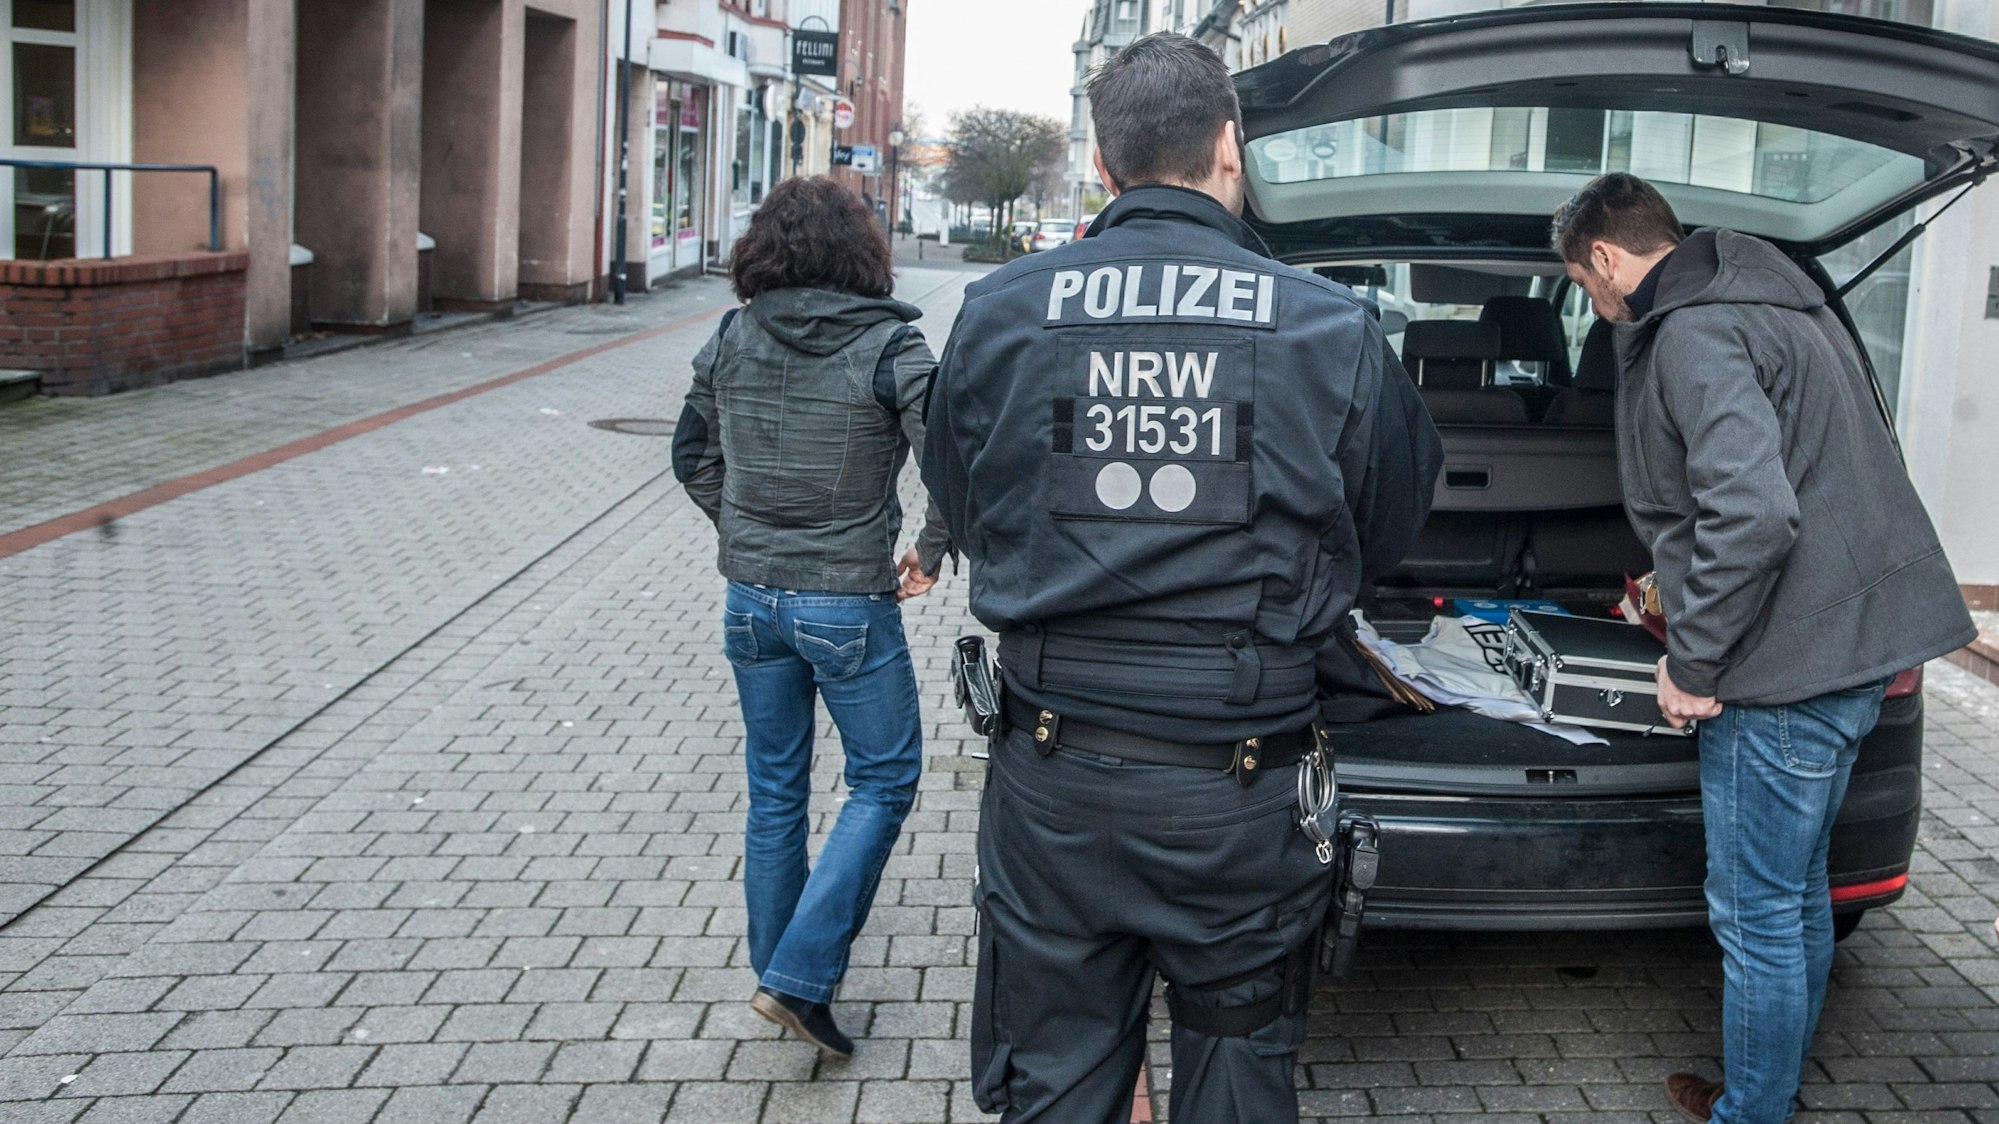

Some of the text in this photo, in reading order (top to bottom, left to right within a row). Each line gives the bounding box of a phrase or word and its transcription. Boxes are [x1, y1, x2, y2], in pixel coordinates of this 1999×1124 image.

[796, 40, 833, 57] FELLINI
[1047, 265, 1274, 323] POLIZEI
[1089, 351, 1218, 398] NRW
[1085, 404, 1221, 455] 31531
